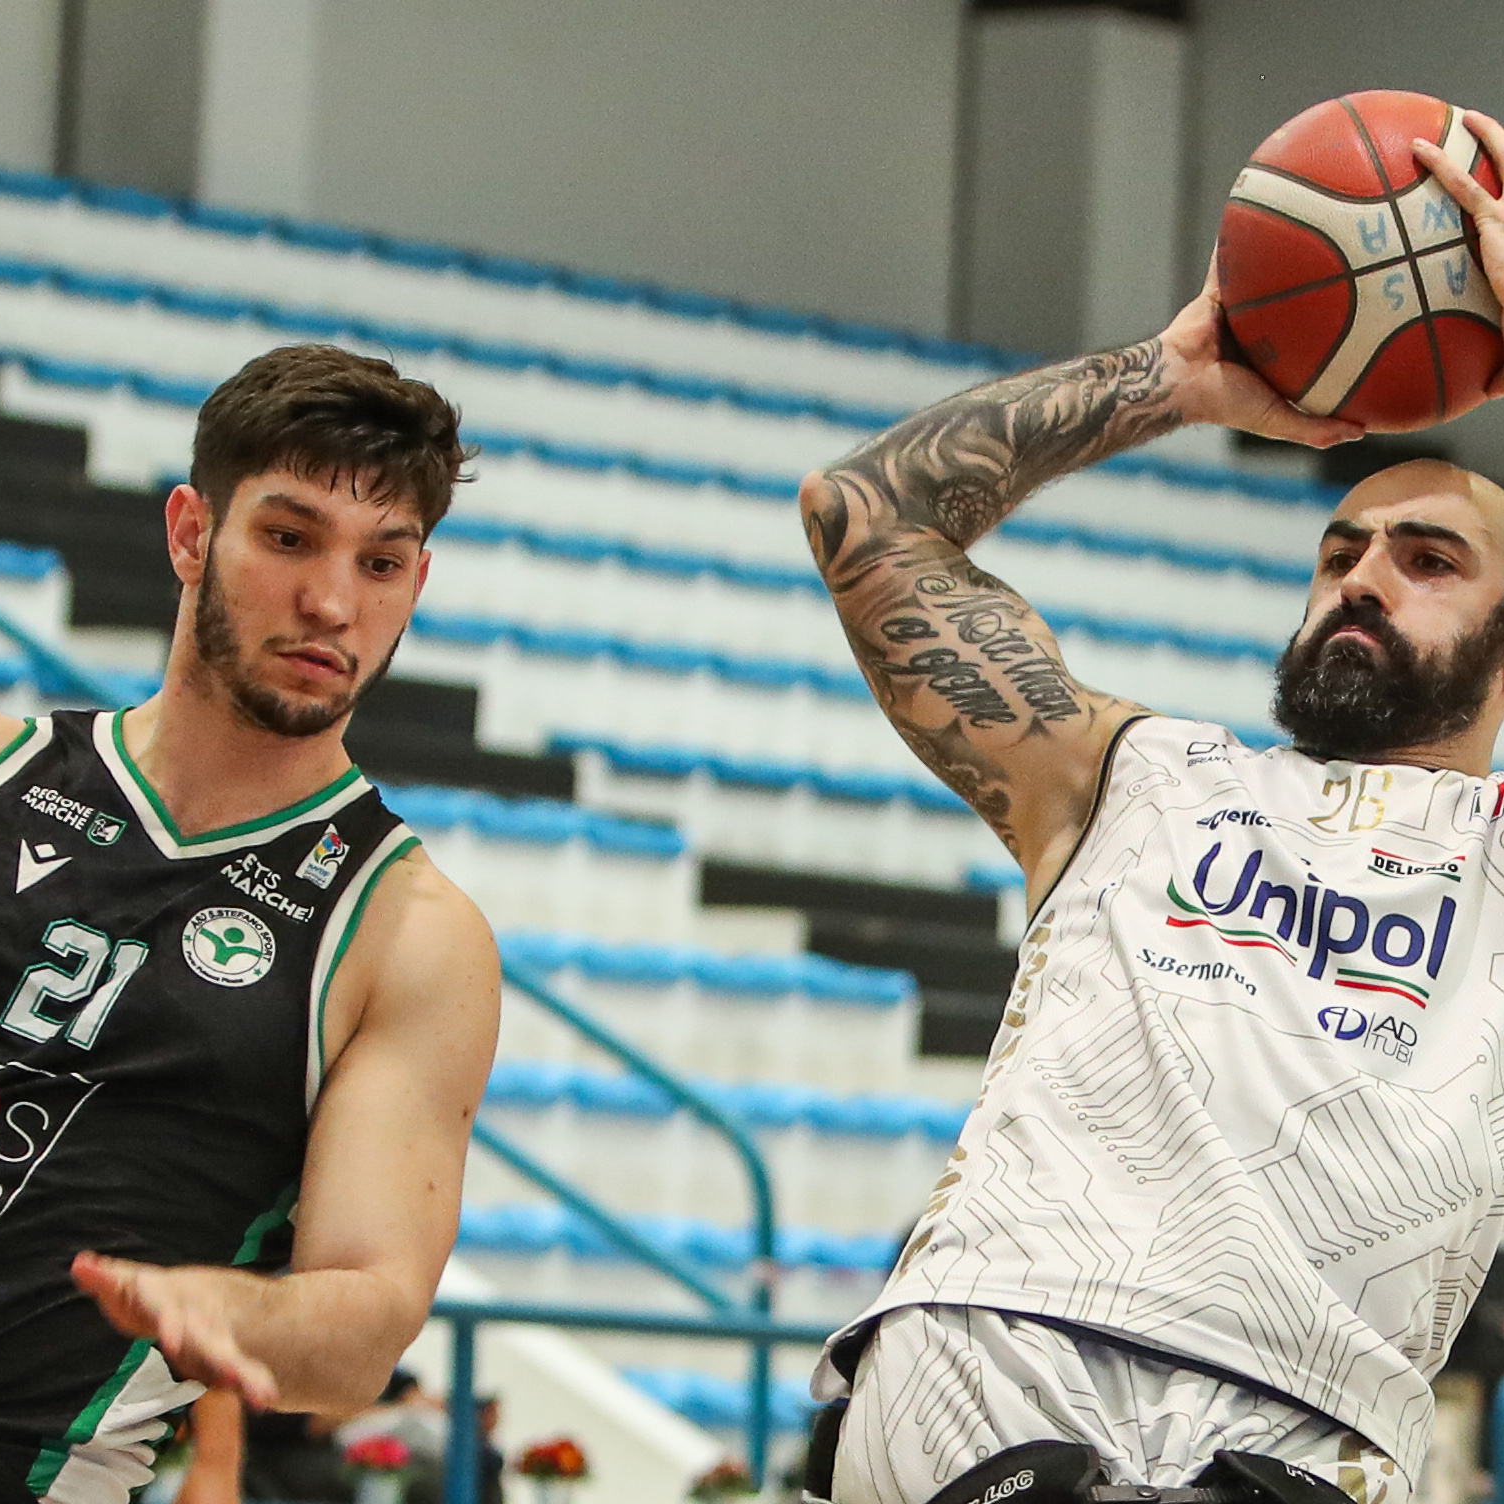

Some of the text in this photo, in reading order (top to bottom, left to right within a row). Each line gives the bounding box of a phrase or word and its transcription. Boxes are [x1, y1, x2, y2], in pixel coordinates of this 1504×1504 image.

[21, 793, 87, 831] MARCHE
[29, 785, 95, 818] REGIONE
[1307, 769, 1394, 833] 26
[235, 852, 282, 890] ET'S
[220, 864, 315, 923] MARCHE!
[1192, 842, 1457, 981] Unipol
[0, 918, 150, 1051] 21
[1370, 1032, 1413, 1067] TUBI
[1373, 1015, 1418, 1047] AD
